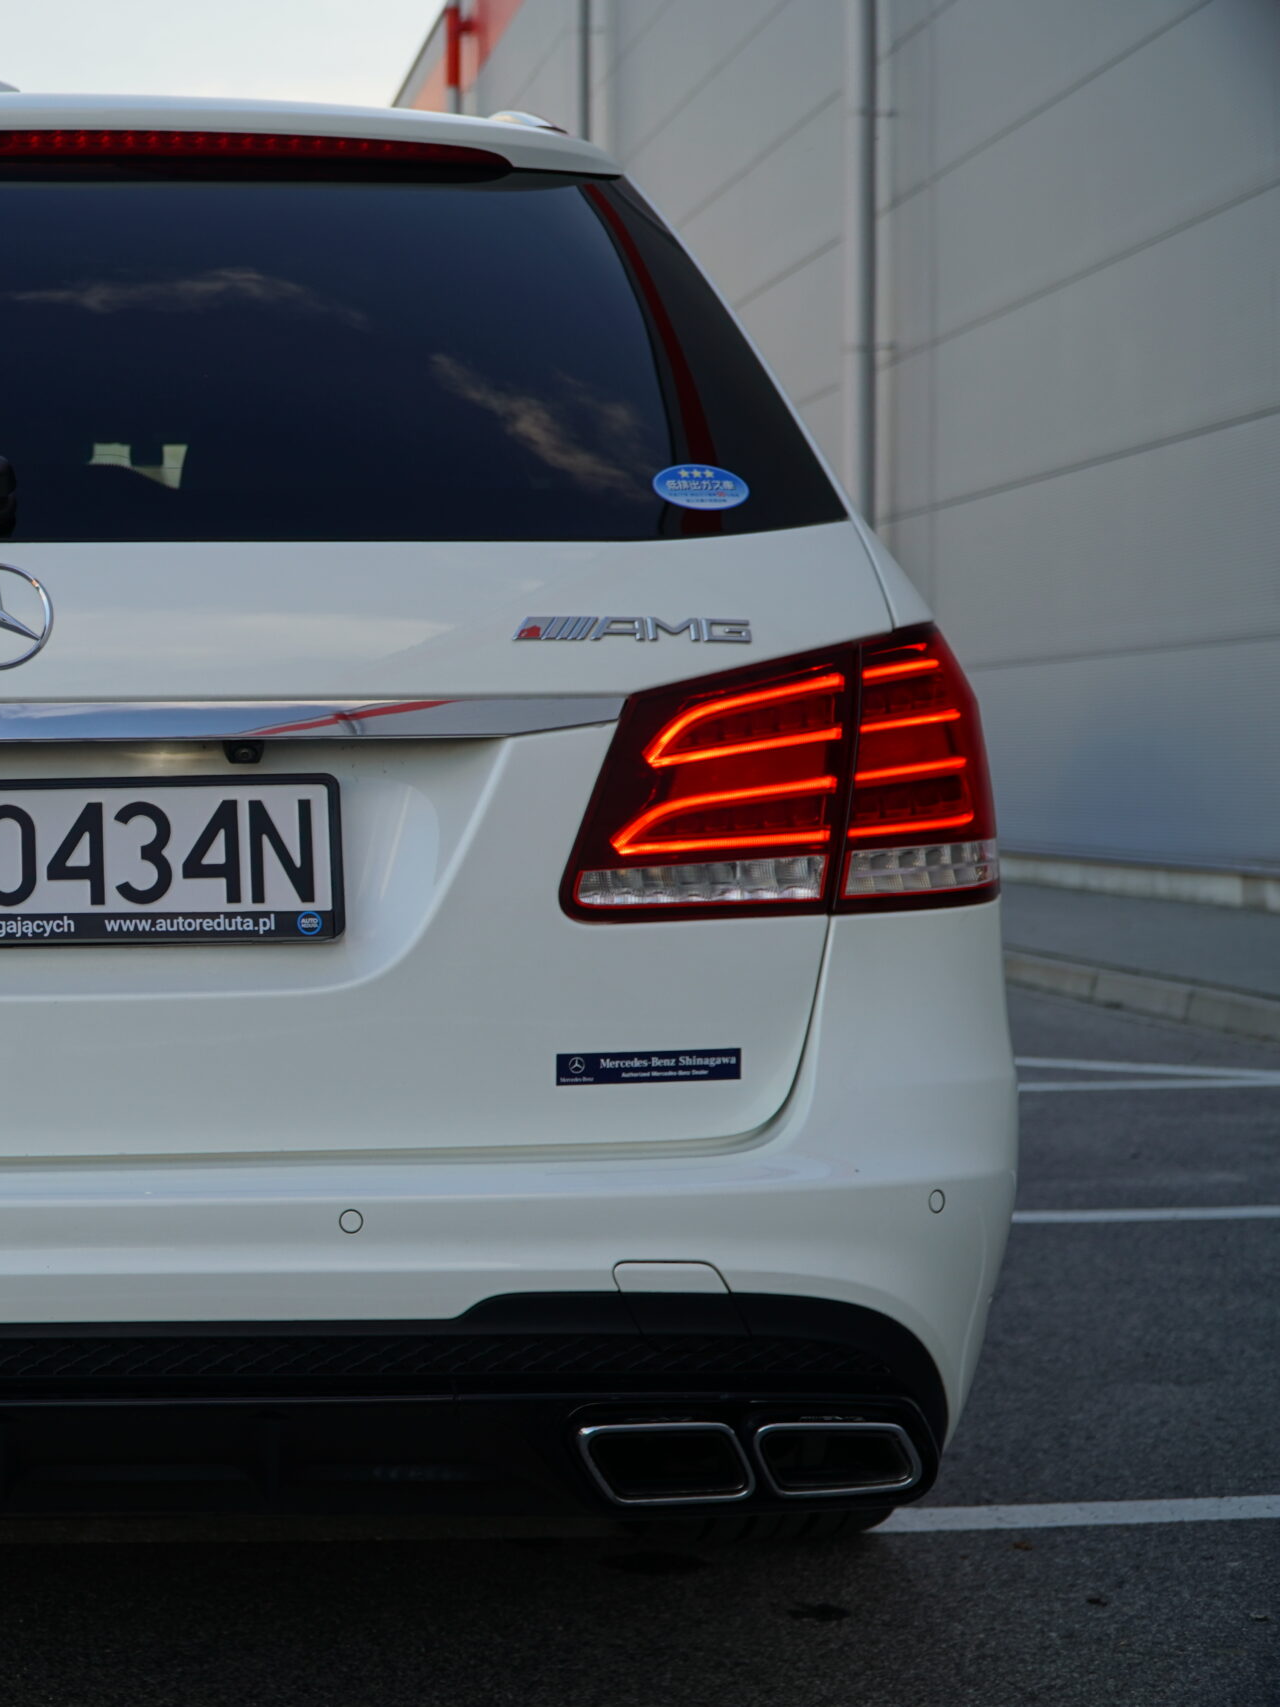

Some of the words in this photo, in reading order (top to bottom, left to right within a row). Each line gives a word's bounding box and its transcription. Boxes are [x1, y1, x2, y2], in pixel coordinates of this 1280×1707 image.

[590, 616, 752, 643] AMG
[104, 913, 276, 935] www.autoreduta.pl
[599, 1056, 676, 1069] Mercedes-Benz
[678, 1055, 737, 1068] Shinagawa
